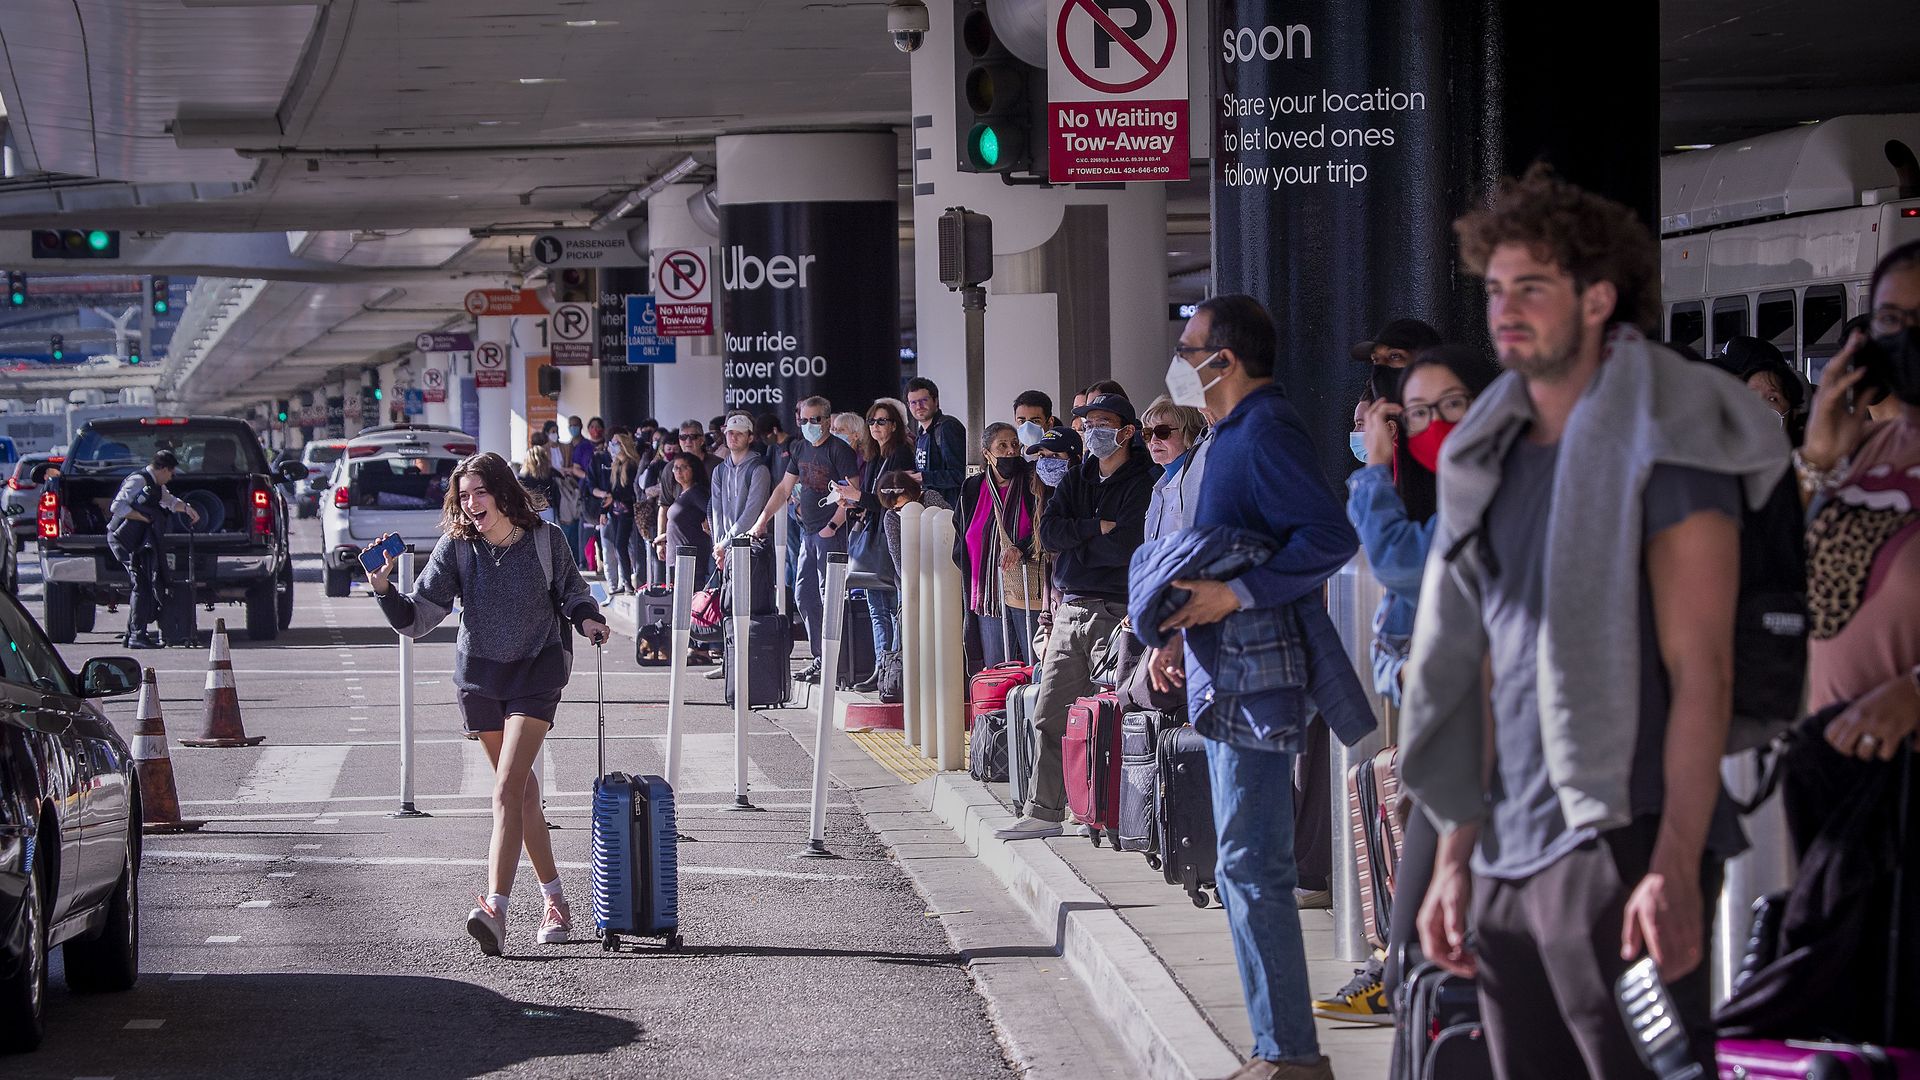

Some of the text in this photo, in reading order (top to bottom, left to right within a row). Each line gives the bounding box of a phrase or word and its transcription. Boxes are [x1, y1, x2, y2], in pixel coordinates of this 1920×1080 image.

[1222, 23, 1312, 64] soon
[1223, 87, 1426, 121] Share your location
[1058, 107, 1178, 130] No Waiting
[1061, 131, 1175, 153] Tow-Away
[1224, 123, 1395, 152] to let loved ones
[1076, 167, 1102, 175] TOWED
[1123, 166, 1170, 174] 424-646-6100
[1224, 158, 1368, 191] follow your trip
[566, 239, 625, 248] PASSENGER
[566, 251, 604, 260] PICKUP
[721, 244, 816, 291] Uber
[659, 305, 708, 315] No Waiting
[661, 315, 707, 325] Tow-Away
[534, 317, 548, 348] 1
[629, 336, 656, 346] LOADING
[657, 335, 674, 345] ZONE
[724, 330, 797, 352] Your ride
[642, 346, 660, 356] ONLY
[724, 355, 827, 378] at over 600
[725, 384, 783, 408] airports
